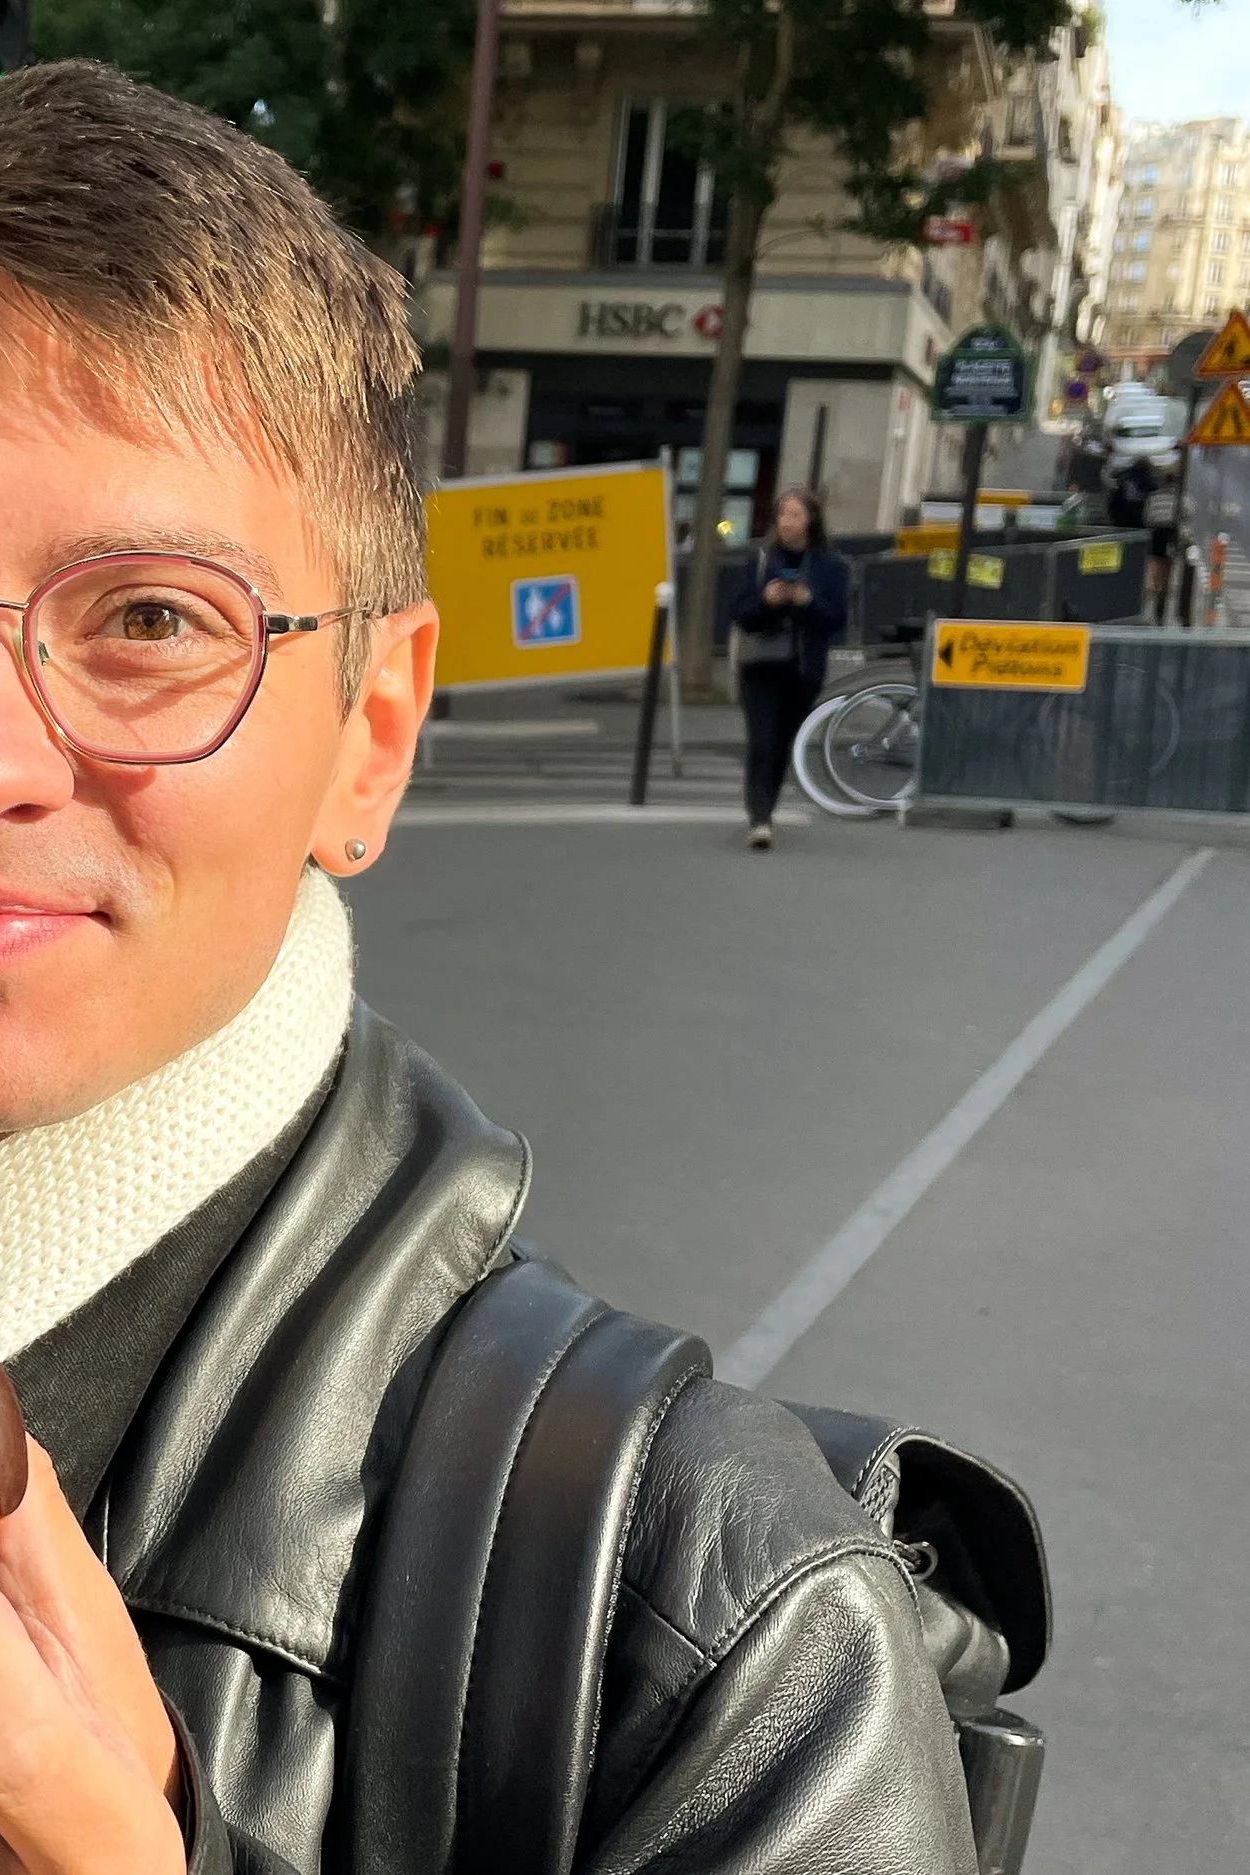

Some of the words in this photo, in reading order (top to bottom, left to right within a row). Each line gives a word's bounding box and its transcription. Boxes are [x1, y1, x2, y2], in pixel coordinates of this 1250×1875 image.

[576, 302, 686, 339] HSBC
[473, 507, 509, 526] FIN
[547, 497, 604, 521] ZONE
